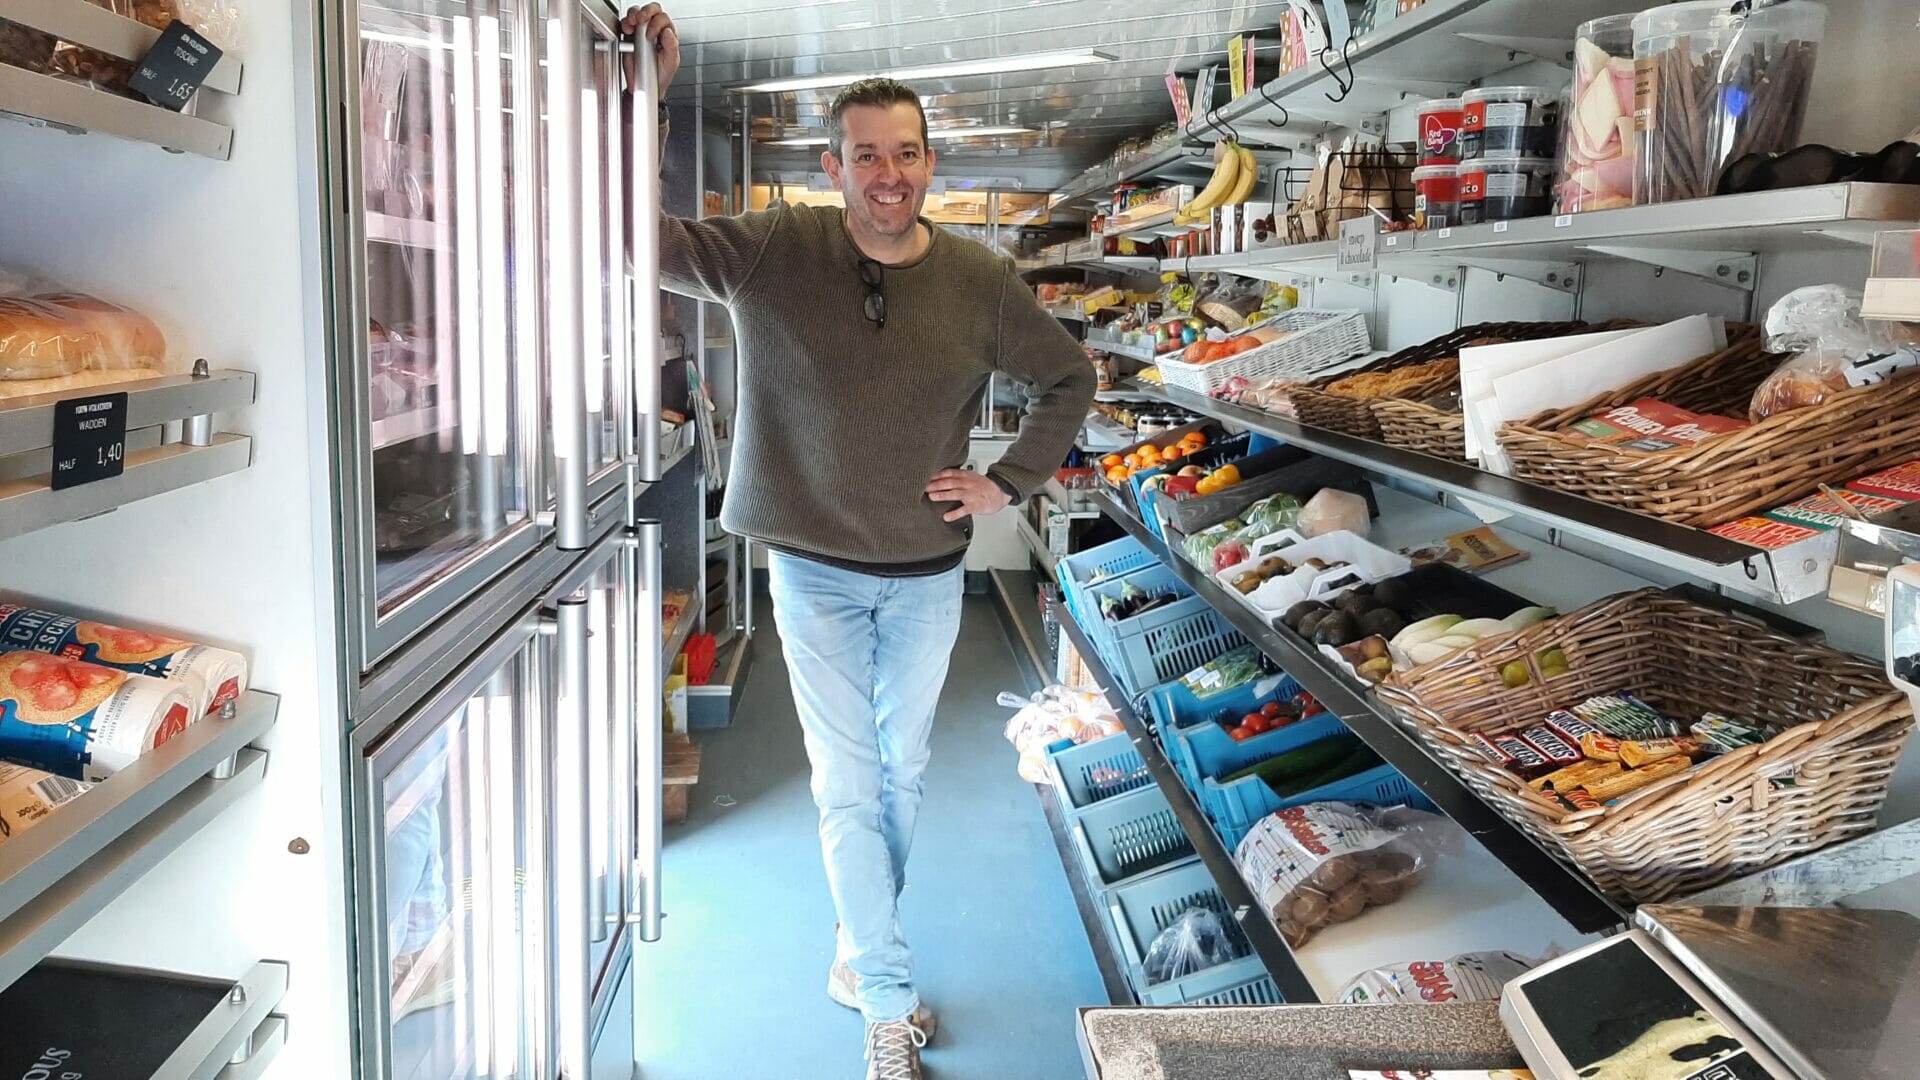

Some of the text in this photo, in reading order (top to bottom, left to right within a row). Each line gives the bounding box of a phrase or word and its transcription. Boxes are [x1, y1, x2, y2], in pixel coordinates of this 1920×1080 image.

[174, 46, 198, 66] TOSCANE
[140, 67, 194, 99] HALF 1,65
[1428, 129, 1442, 137] Red
[79, 417, 107, 430] WADDEN
[59, 442, 122, 471] HALF 1,40
[1546, 710, 1593, 741] SNICKER
[1521, 727, 1576, 759] SNICKERS
